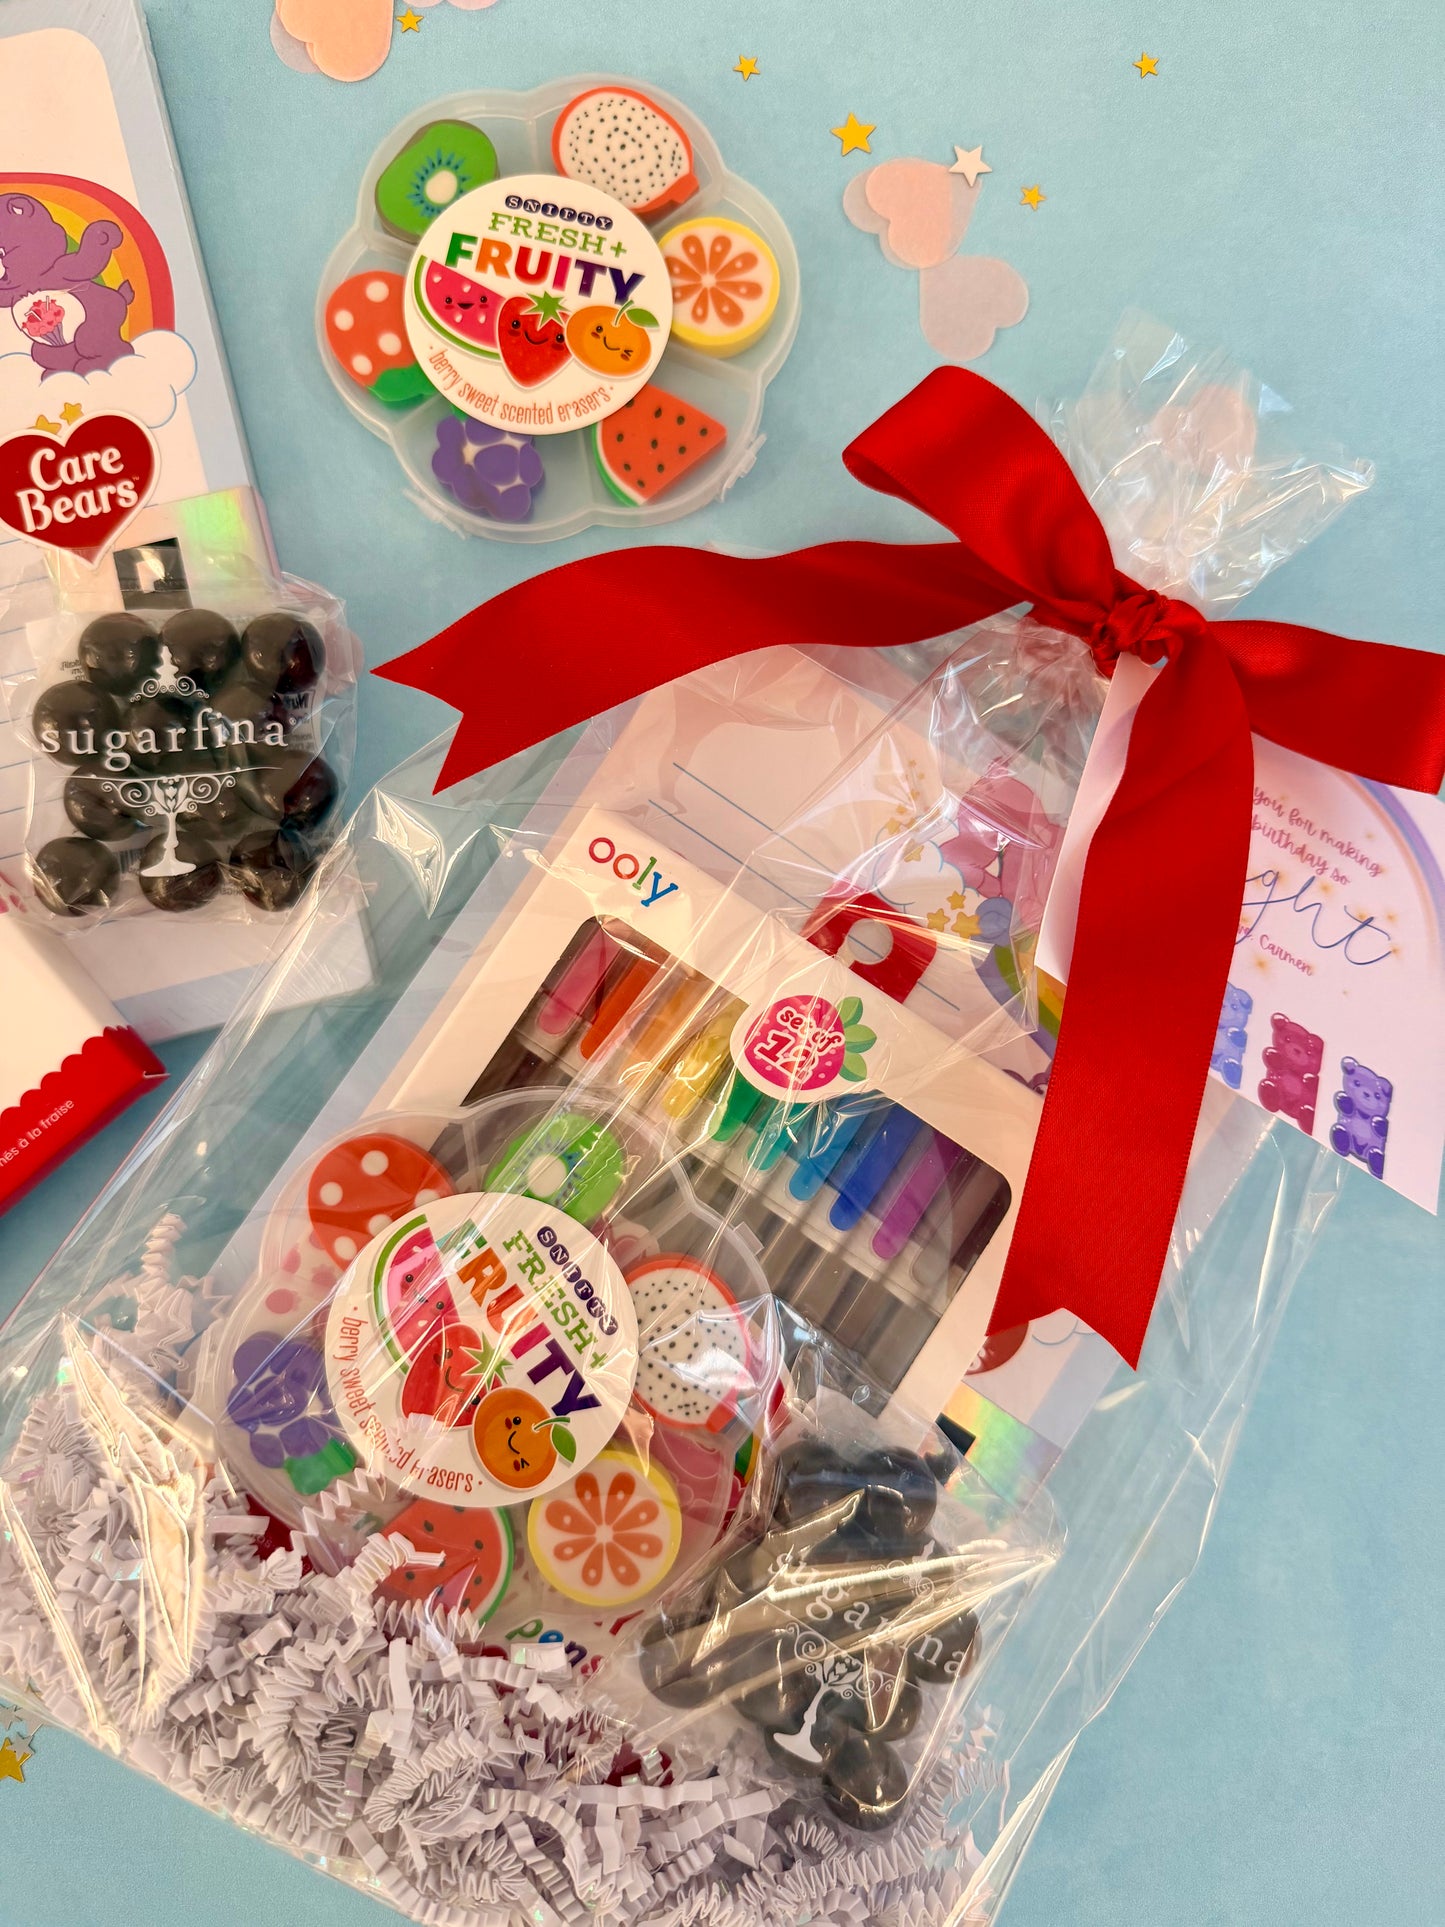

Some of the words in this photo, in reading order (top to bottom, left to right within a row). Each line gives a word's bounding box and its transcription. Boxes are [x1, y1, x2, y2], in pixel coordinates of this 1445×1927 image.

[505, 194, 613, 231] SNIFTY
[444, 232, 645, 304] FRUITY
[428, 349, 461, 391] berry
[457, 381, 500, 416] sweet
[500, 402, 553, 426] scented
[558, 385, 612, 423] erasers
[30, 448, 124, 491] Care
[1251, 814, 1329, 876] birthday
[1331, 868, 1350, 885] so
[1252, 787, 1285, 818] you
[1288, 807, 1317, 837] for
[1319, 827, 1382, 877] making
[588, 837, 679, 908] ooly
[1259, 934, 1314, 977] Carmen
[26, 1127, 43, 1140] la
[39, 1099, 75, 1130] fraise
[537, 1225, 619, 1336] SNIFTY
[333, 1316, 368, 1363] berry
[340, 1367, 376, 1417] sweet
